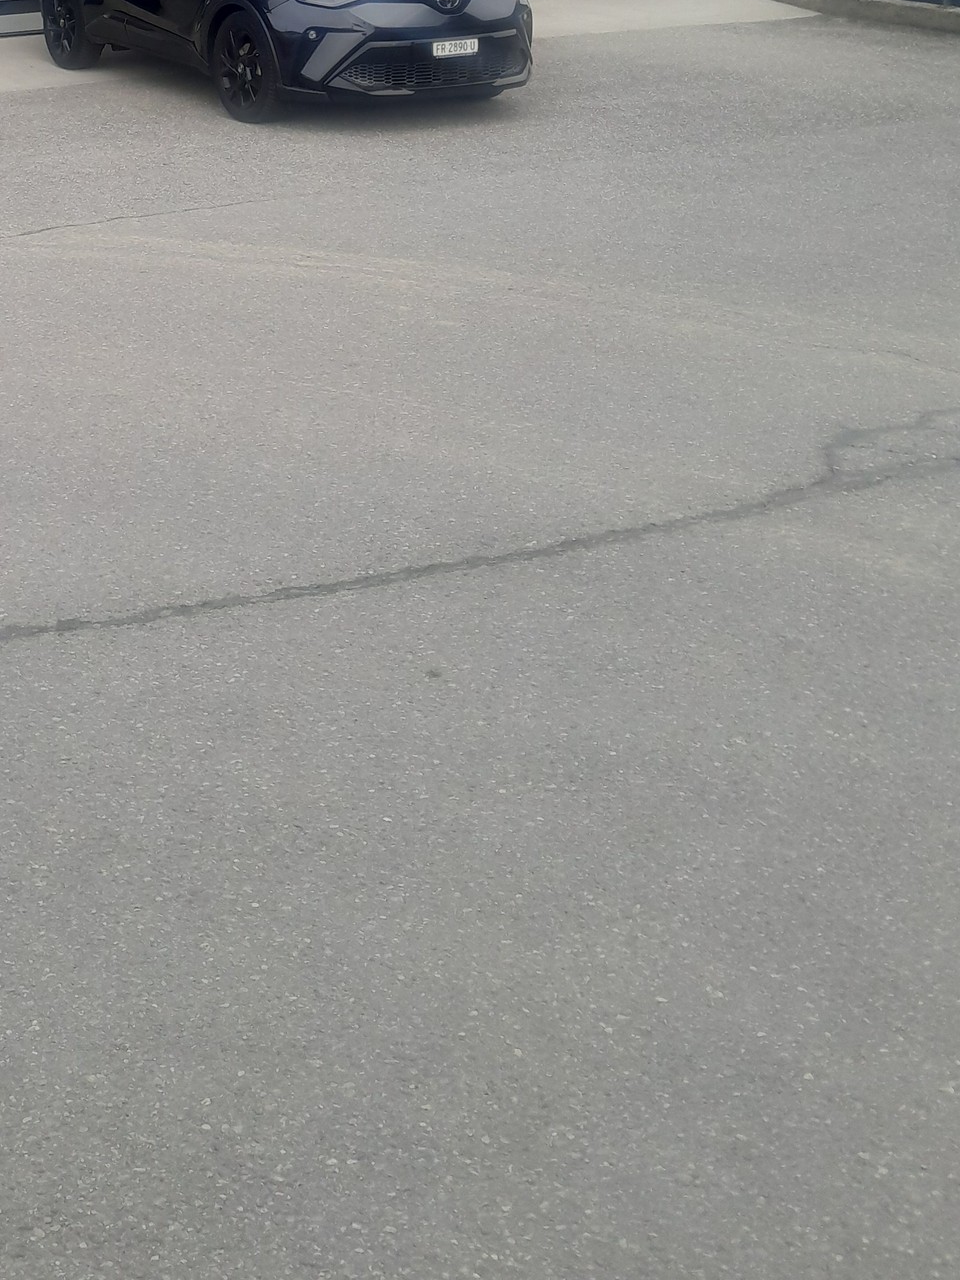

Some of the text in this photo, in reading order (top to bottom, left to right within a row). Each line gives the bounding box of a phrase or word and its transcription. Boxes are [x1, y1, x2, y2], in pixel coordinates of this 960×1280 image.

[435, 40, 476, 55] FR 2890 U
